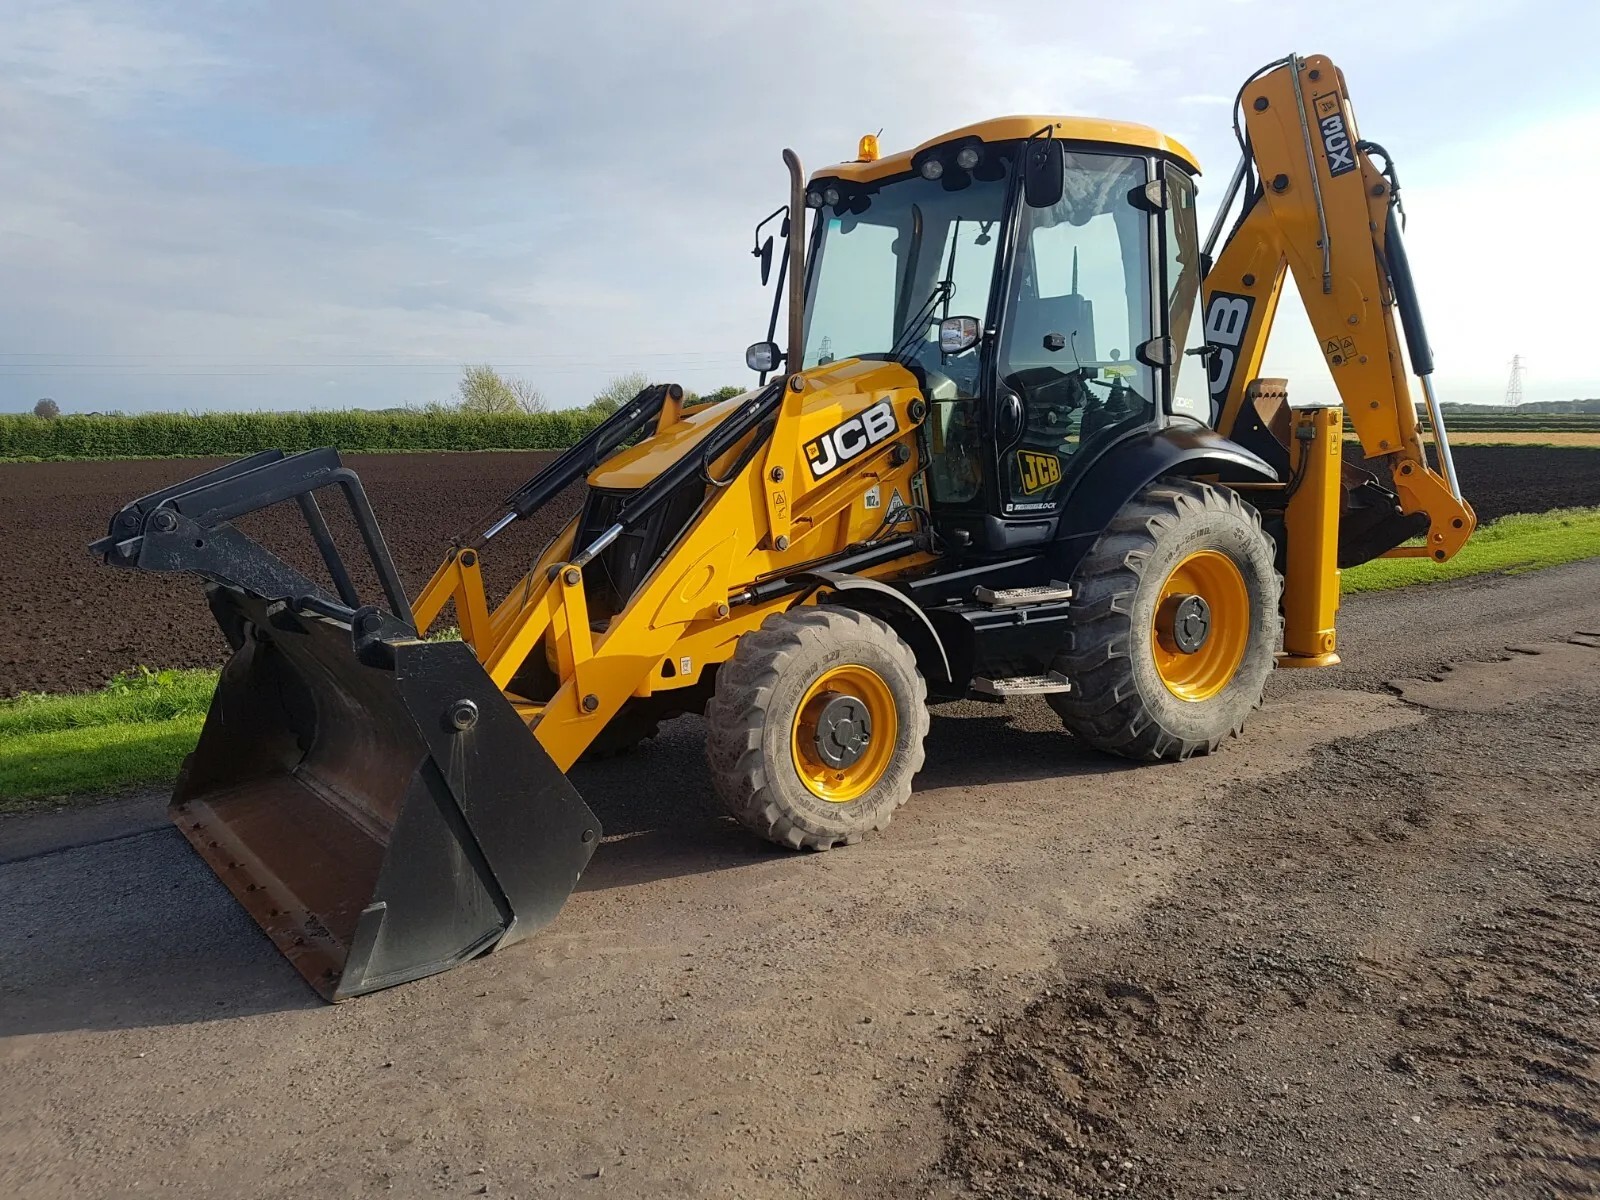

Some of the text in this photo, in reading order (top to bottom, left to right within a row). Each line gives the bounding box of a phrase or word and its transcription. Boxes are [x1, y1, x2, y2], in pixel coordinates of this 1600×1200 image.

[1321, 115, 1354, 170] 3CX
[811, 402, 896, 475] JCB
[1025, 454, 1059, 490] JCB
